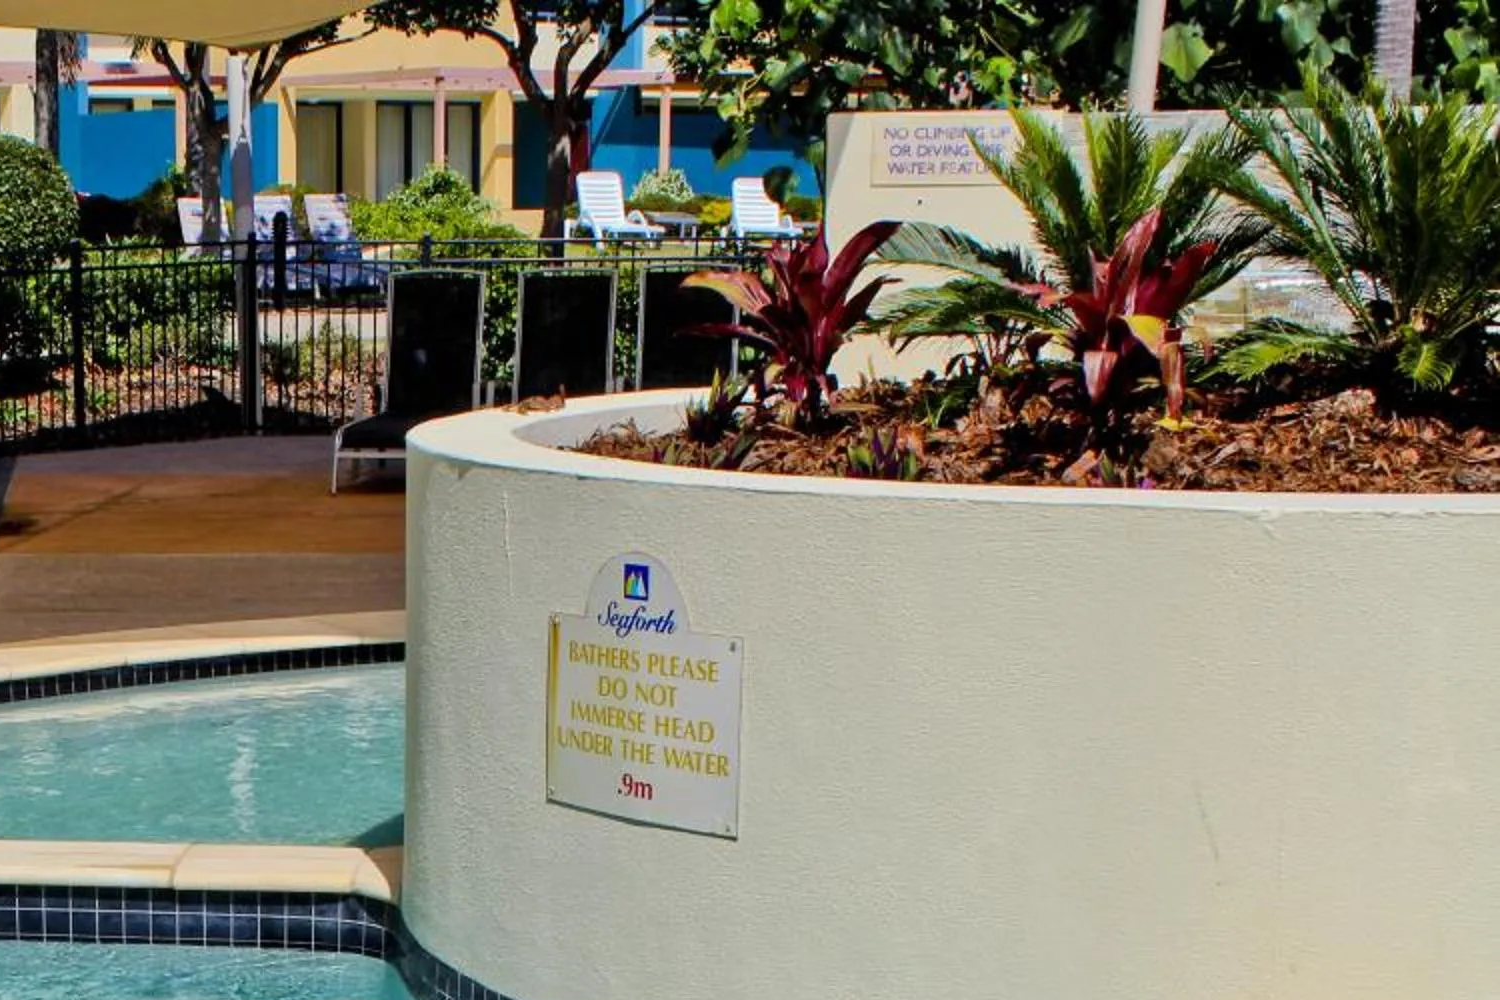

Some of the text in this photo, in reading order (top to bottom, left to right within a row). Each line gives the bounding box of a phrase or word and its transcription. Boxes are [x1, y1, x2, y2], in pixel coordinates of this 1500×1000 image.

[884, 127, 909, 140] NO
[890, 144, 911, 157] OR
[917, 144, 969, 157] DIVING
[887, 161, 935, 174] WATER
[597, 601, 676, 636] Seaforth
[569, 641, 720, 682] BATHERS PLEASE
[598, 676, 676, 708] DO NOT
[570, 701, 715, 744] IMMERSE HEAD
[557, 727, 730, 776] UNDER THE WATER
[617, 773, 653, 800] .9m
